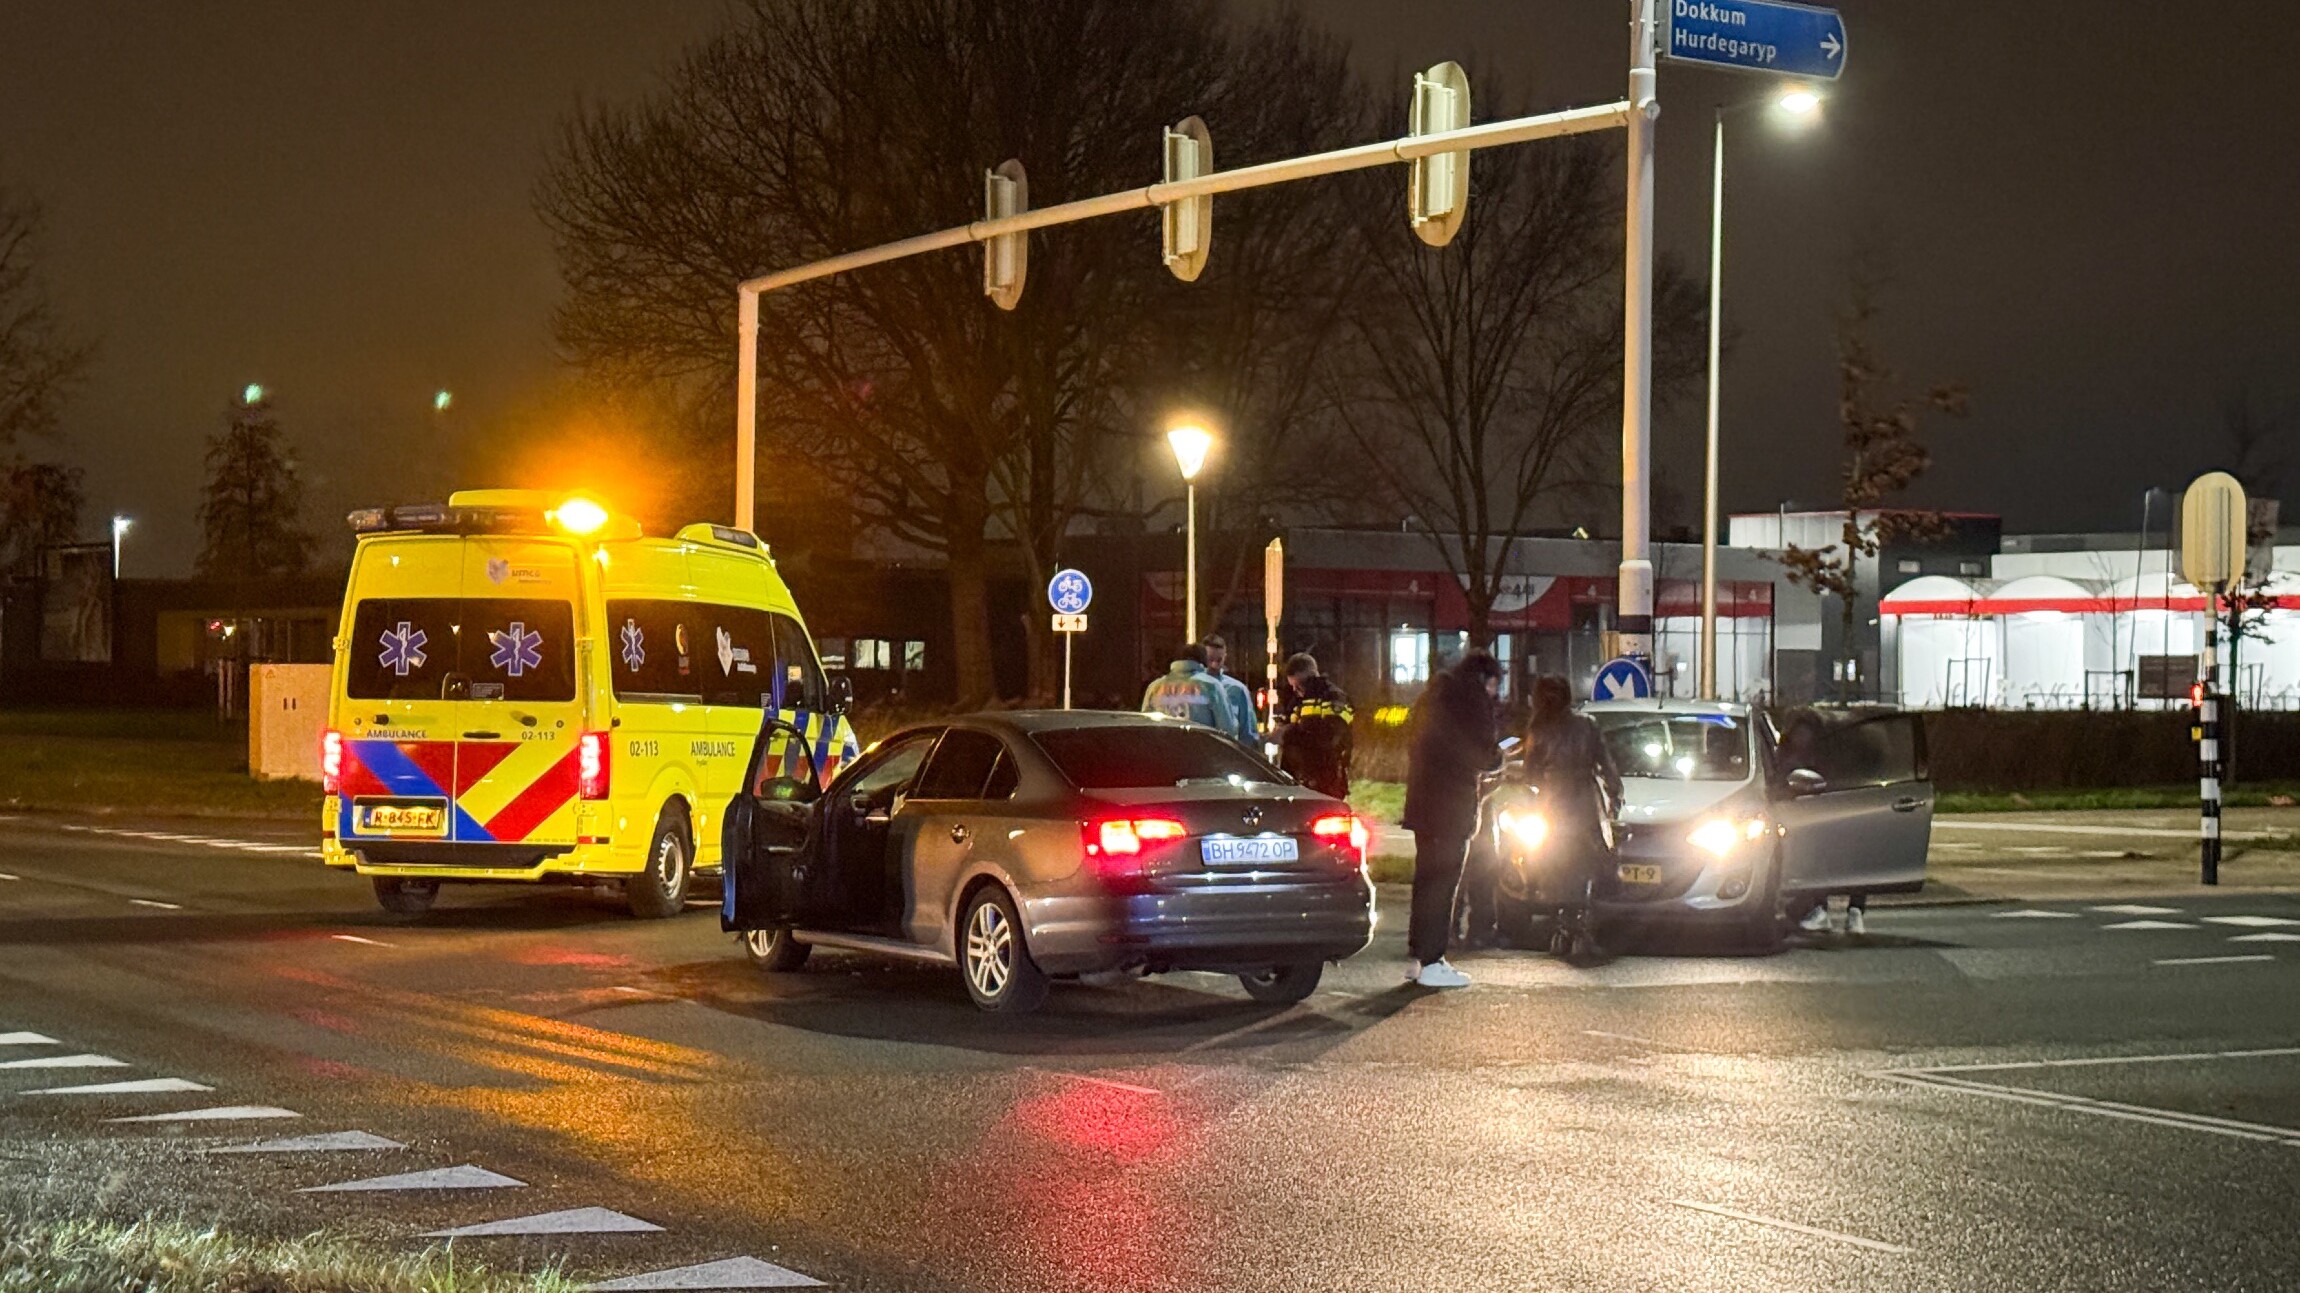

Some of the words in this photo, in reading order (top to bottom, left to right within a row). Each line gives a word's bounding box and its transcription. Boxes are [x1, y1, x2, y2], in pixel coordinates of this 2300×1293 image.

[1675, 0, 1746, 26] Dokkum
[1675, 27, 1777, 63] Hurdegaryp
[366, 729, 427, 739] AMBULANCE
[521, 731, 556, 741] 02-113
[629, 740, 659, 757] 02-113
[690, 741, 736, 757] AMBULANCE
[1211, 842, 1234, 860] BH
[1236, 842, 1269, 859] 9472
